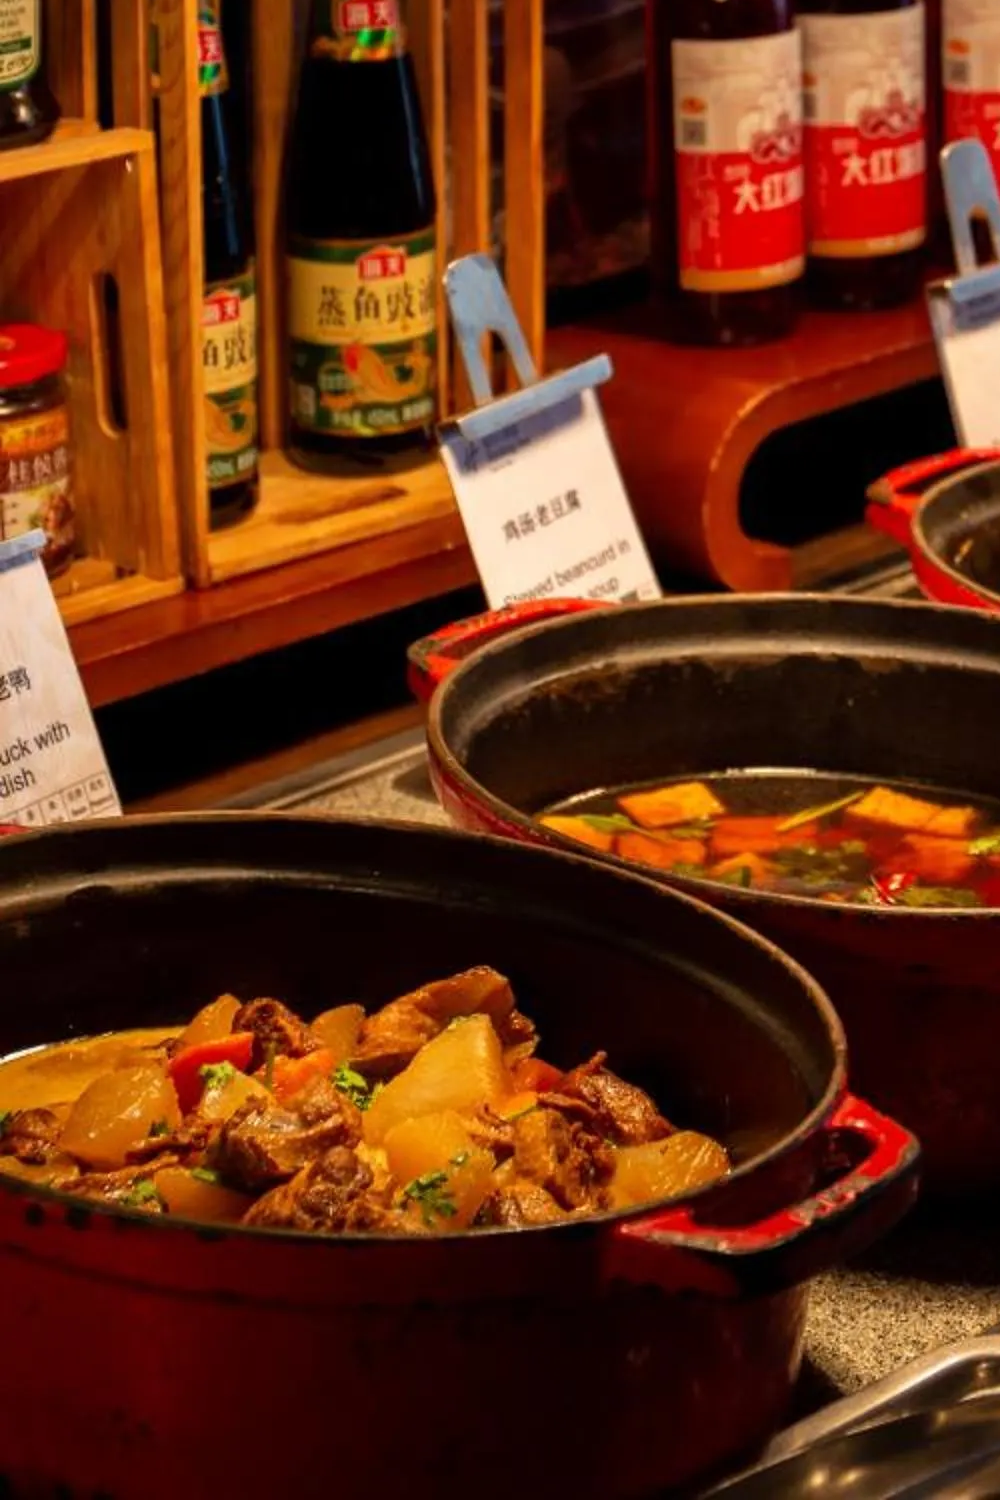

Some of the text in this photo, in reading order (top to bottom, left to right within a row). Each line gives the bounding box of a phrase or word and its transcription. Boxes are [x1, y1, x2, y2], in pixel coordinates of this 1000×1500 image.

[554, 545, 617, 587] beancurd
[617, 539, 632, 556] in
[34, 722, 70, 750] with
